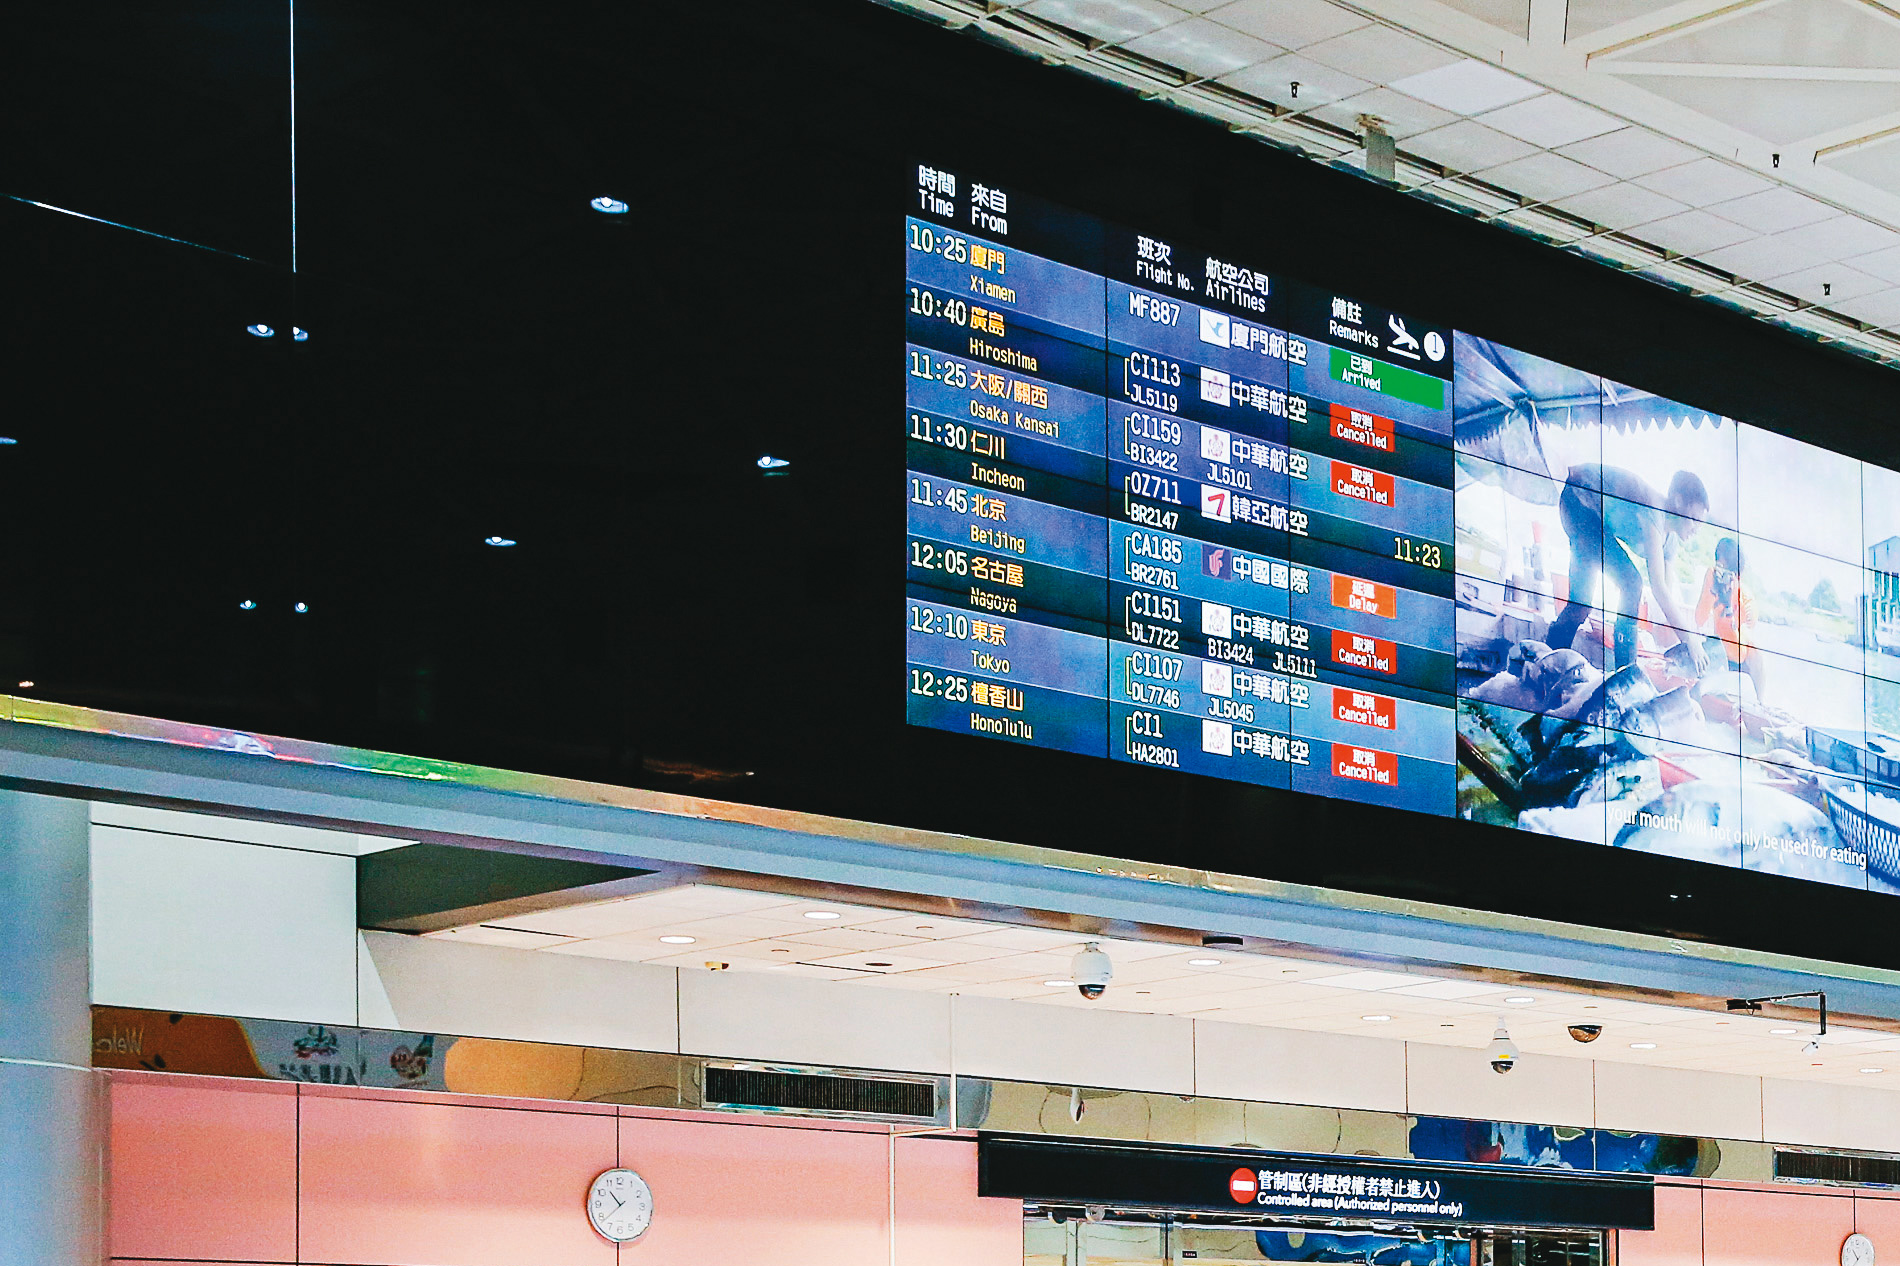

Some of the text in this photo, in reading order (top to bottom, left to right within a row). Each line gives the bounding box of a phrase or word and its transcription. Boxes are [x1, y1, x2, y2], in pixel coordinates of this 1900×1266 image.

[918, 166, 1007, 213] 時間 來自
[919, 190, 1008, 235] Time From
[910, 225, 1006, 274] 10:25 廈門
[1136, 261, 1194, 291] Flight No.
[1137, 236, 1269, 296] 班次 航空公司
[970, 275, 1016, 303] Xiamen
[1206, 281, 1265, 312] Airlines
[910, 288, 1006, 336] 10:40 廣島
[1129, 294, 1180, 326] MF887
[1331, 297, 1362, 325] 備註
[1231, 323, 1308, 366] 廈門航空
[1330, 320, 1379, 348] Remarks
[970, 337, 1038, 372] Hiroshima
[1130, 352, 1181, 387] CI113
[910, 352, 1048, 409] 11:25 大阪/關西
[1342, 368, 1381, 392] Arrived
[1130, 382, 1178, 412] JL5119
[1232, 381, 1308, 424] 中華航空
[970, 401, 1060, 438] Osaka Kansai
[1130, 412, 1181, 445] CI159
[1350, 410, 1373, 431] 取消
[910, 415, 1006, 460] 11:30 仁川
[1337, 423, 1387, 449] Cancelled
[1130, 442, 1178, 471] BI3422
[1232, 439, 1308, 481] 中華航空
[971, 462, 1025, 491] Incheon
[1131, 472, 1181, 505] OZ711
[1207, 464, 1252, 491] JL5101
[1351, 467, 1375, 487] 取消
[911, 479, 1007, 522] 11:45 北京
[1337, 479, 1388, 505] Cancelled
[1131, 503, 1179, 531] BR2147
[1232, 495, 1308, 536] 韓亞航空
[970, 523, 1026, 554] Beijing
[1132, 532, 1182, 564] CA185
[1394, 538, 1441, 568] 11:23
[911, 543, 1024, 588] 12:05 名古屋
[1132, 563, 1179, 590] BR2761
[1232, 554, 1309, 595] 中國國際
[970, 587, 1017, 614] Nagoya
[1132, 593, 1182, 624] CI151
[1349, 594, 1377, 614] Delay
[911, 606, 1007, 646] 12:10 東京
[1132, 623, 1180, 650] DL7722
[1233, 612, 1309, 651] 中華航空
[1208, 639, 1317, 679] BI3424 JL5111
[1338, 647, 1389, 672] Cancelled
[1353, 634, 1375, 655] 取消
[971, 648, 1010, 675] Tokyo
[1132, 653, 1182, 682] CI107
[911, 670, 1023, 711] 12:25 檀香山
[1132, 683, 1180, 709] DL7746
[1233, 671, 1309, 708] 中華航空
[1352, 692, 1375, 711] 取消
[1132, 712, 1163, 738] CI1
[1208, 698, 1255, 723] JL5045
[1338, 704, 1389, 728] Cancelled
[970, 712, 1033, 740] Honolulu
[1132, 743, 1180, 768] HA2801
[1233, 730, 1309, 765] 中華航空
[1353, 747, 1375, 767] 取消
[1338, 760, 1390, 784] Cancelled
[1608, 807, 1866, 870] your mouth will not only be used for eating
[1258, 1192, 1463, 1217] Controlled area (Authorized personnel only)
